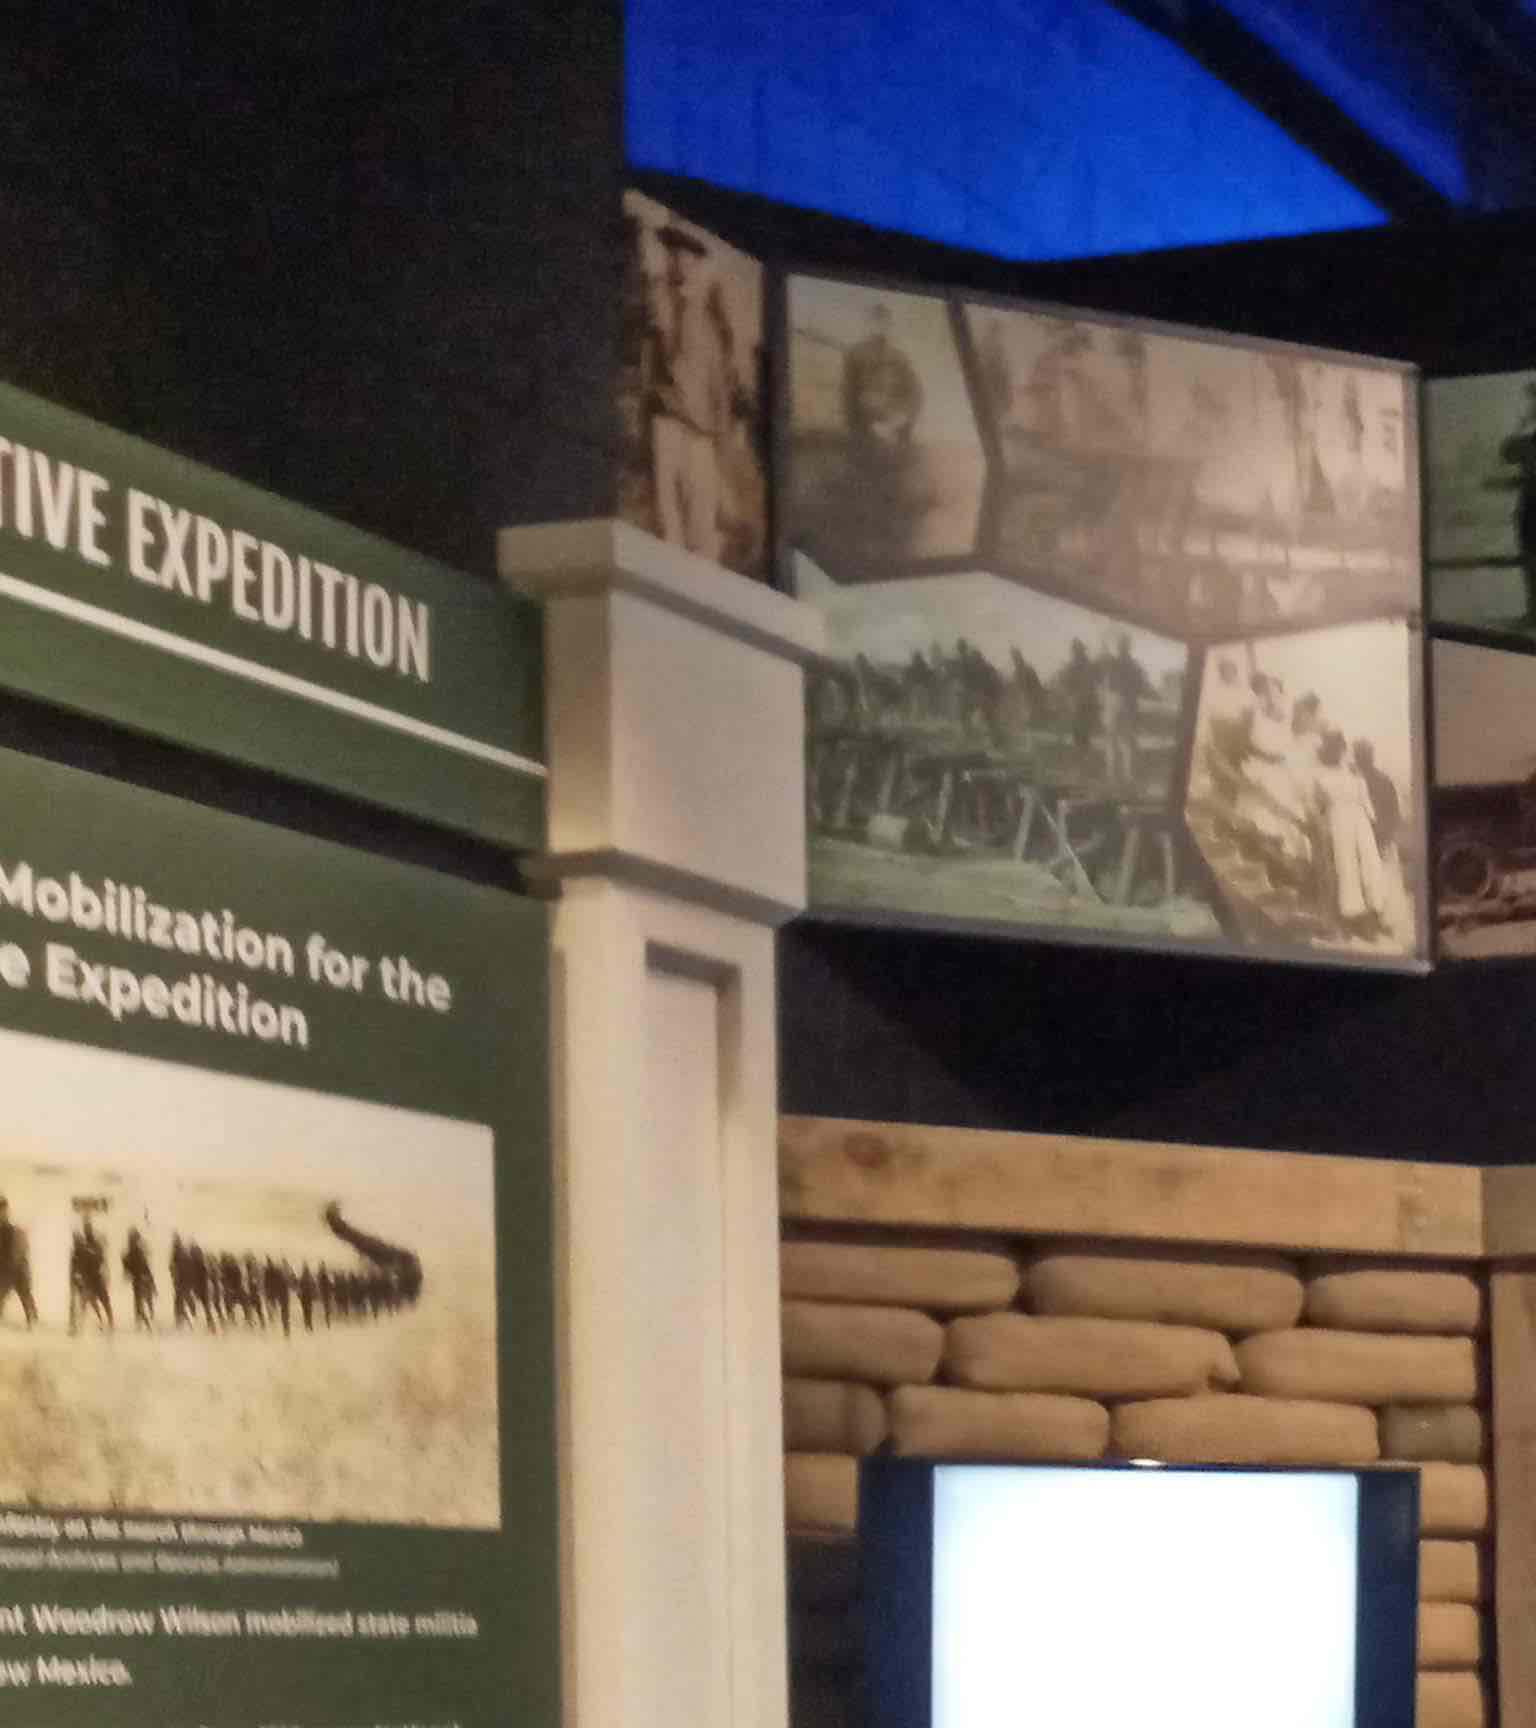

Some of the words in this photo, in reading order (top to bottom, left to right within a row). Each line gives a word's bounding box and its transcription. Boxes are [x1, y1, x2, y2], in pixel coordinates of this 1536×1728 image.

[127, 487, 434, 683] EXPEDITION
[0, 861, 294, 976] Mobilization
[306, 931, 370, 992] for
[380, 955, 451, 1013] the
[46, 941, 308, 1050] Expedition
[32, 1603, 155, 1636] Woodrow
[159, 1604, 242, 1636] Wilson
[245, 1607, 354, 1639] mobilized
[357, 1609, 410, 1640] state
[414, 1611, 479, 1640] militia
